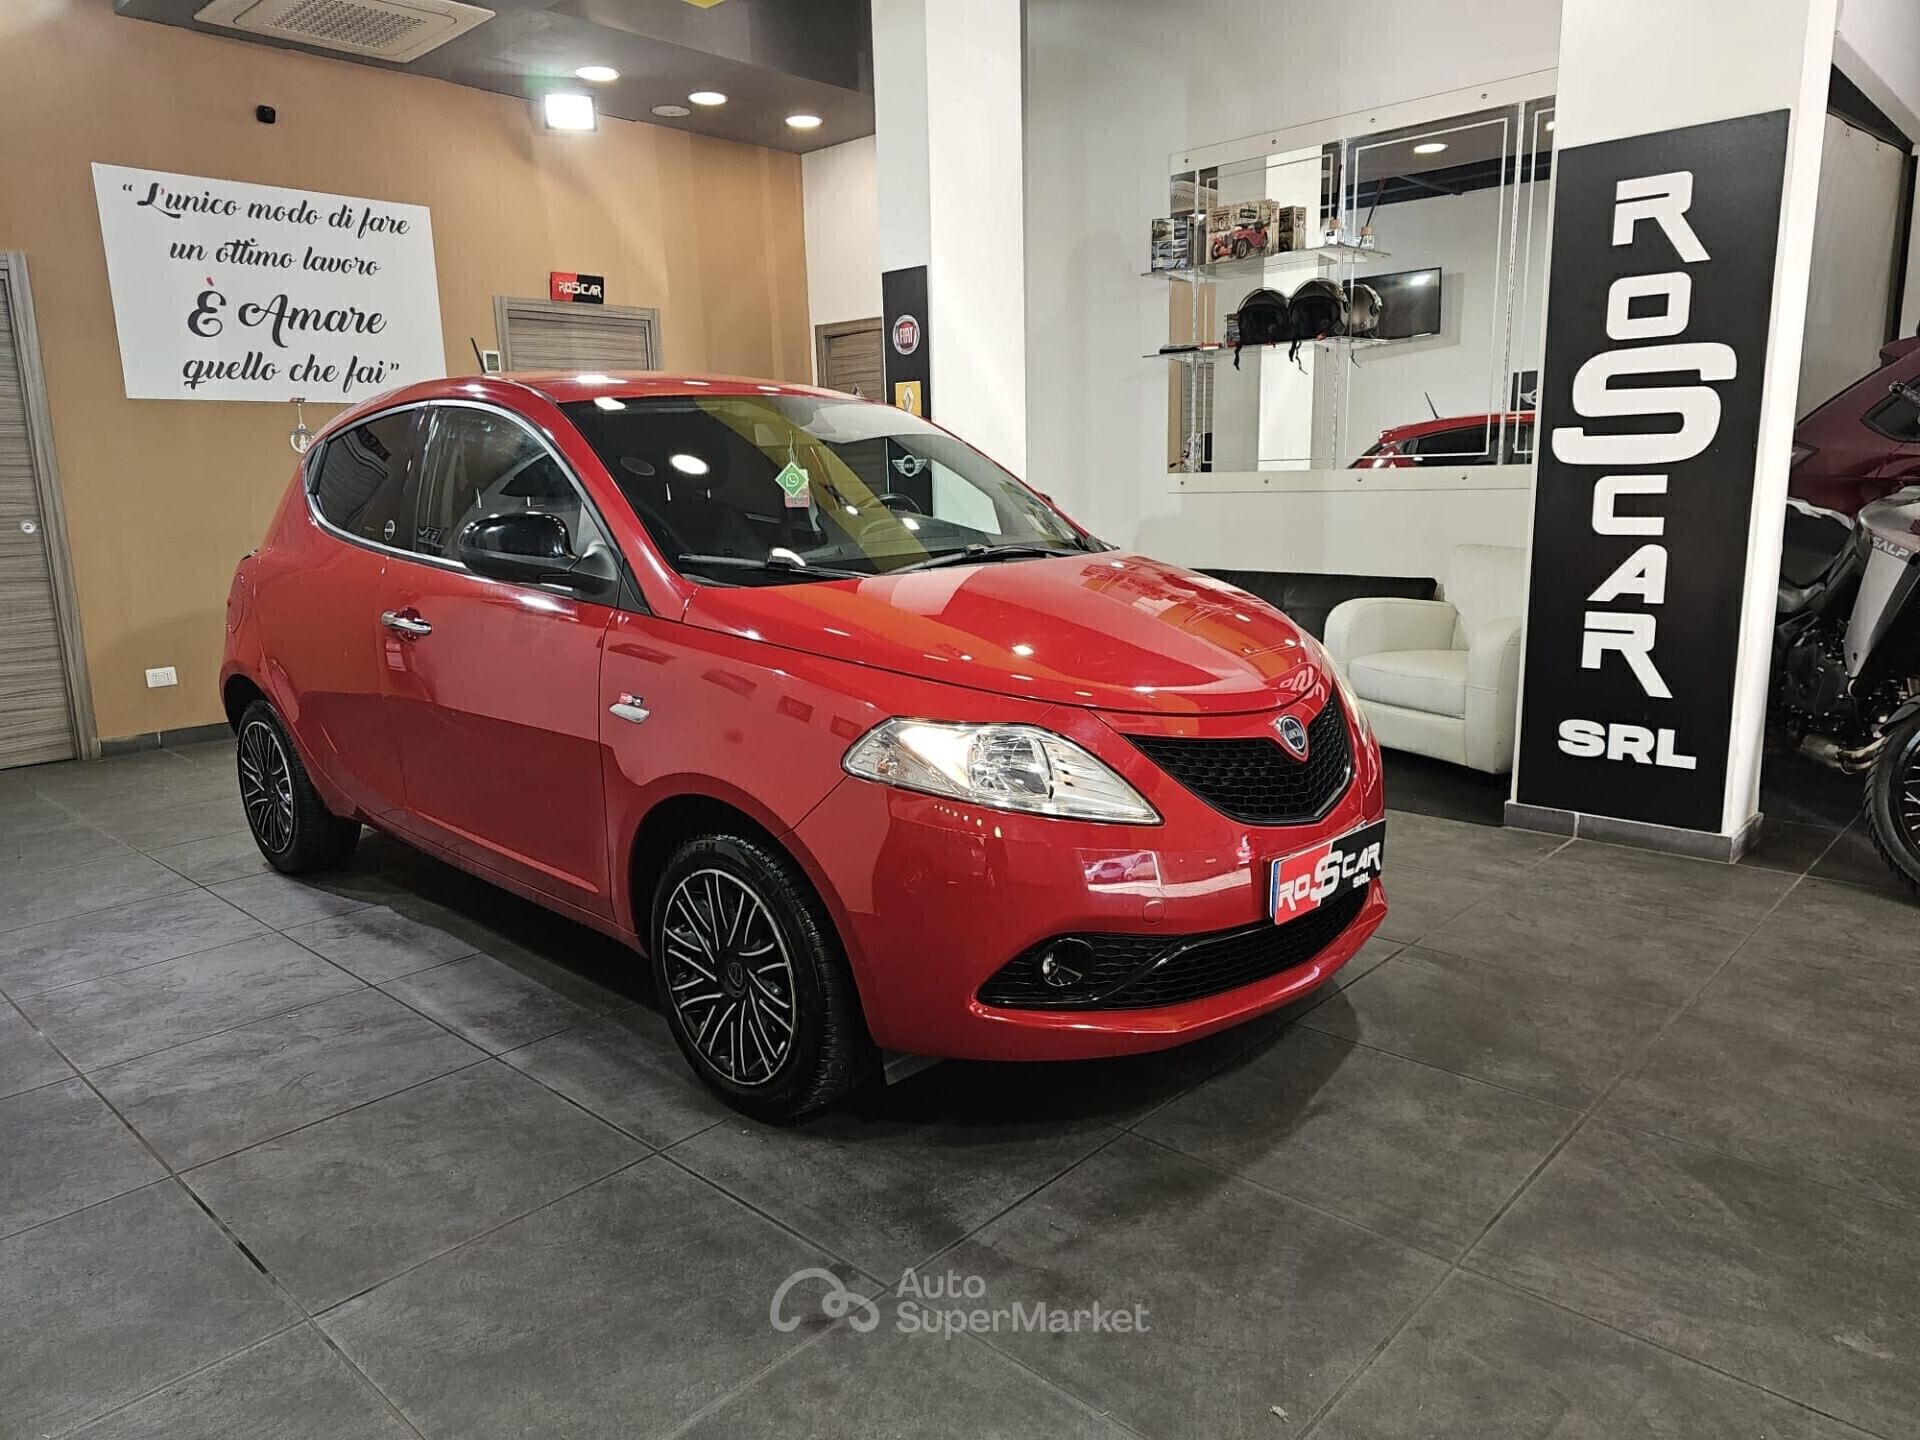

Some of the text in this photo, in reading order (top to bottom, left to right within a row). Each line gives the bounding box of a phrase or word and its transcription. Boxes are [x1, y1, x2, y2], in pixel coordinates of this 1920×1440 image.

[247, 200, 322, 225] modo
[328, 204, 354, 229] di
[357, 207, 411, 240] fare
[169, 237, 382, 276] un ottimo lavoro
[187, 276, 388, 349] È Amare
[182, 351, 281, 391] quello
[288, 353, 340, 384] che
[1557, 718, 1698, 770] SRL
[1352, 871, 1371, 889] SRL
